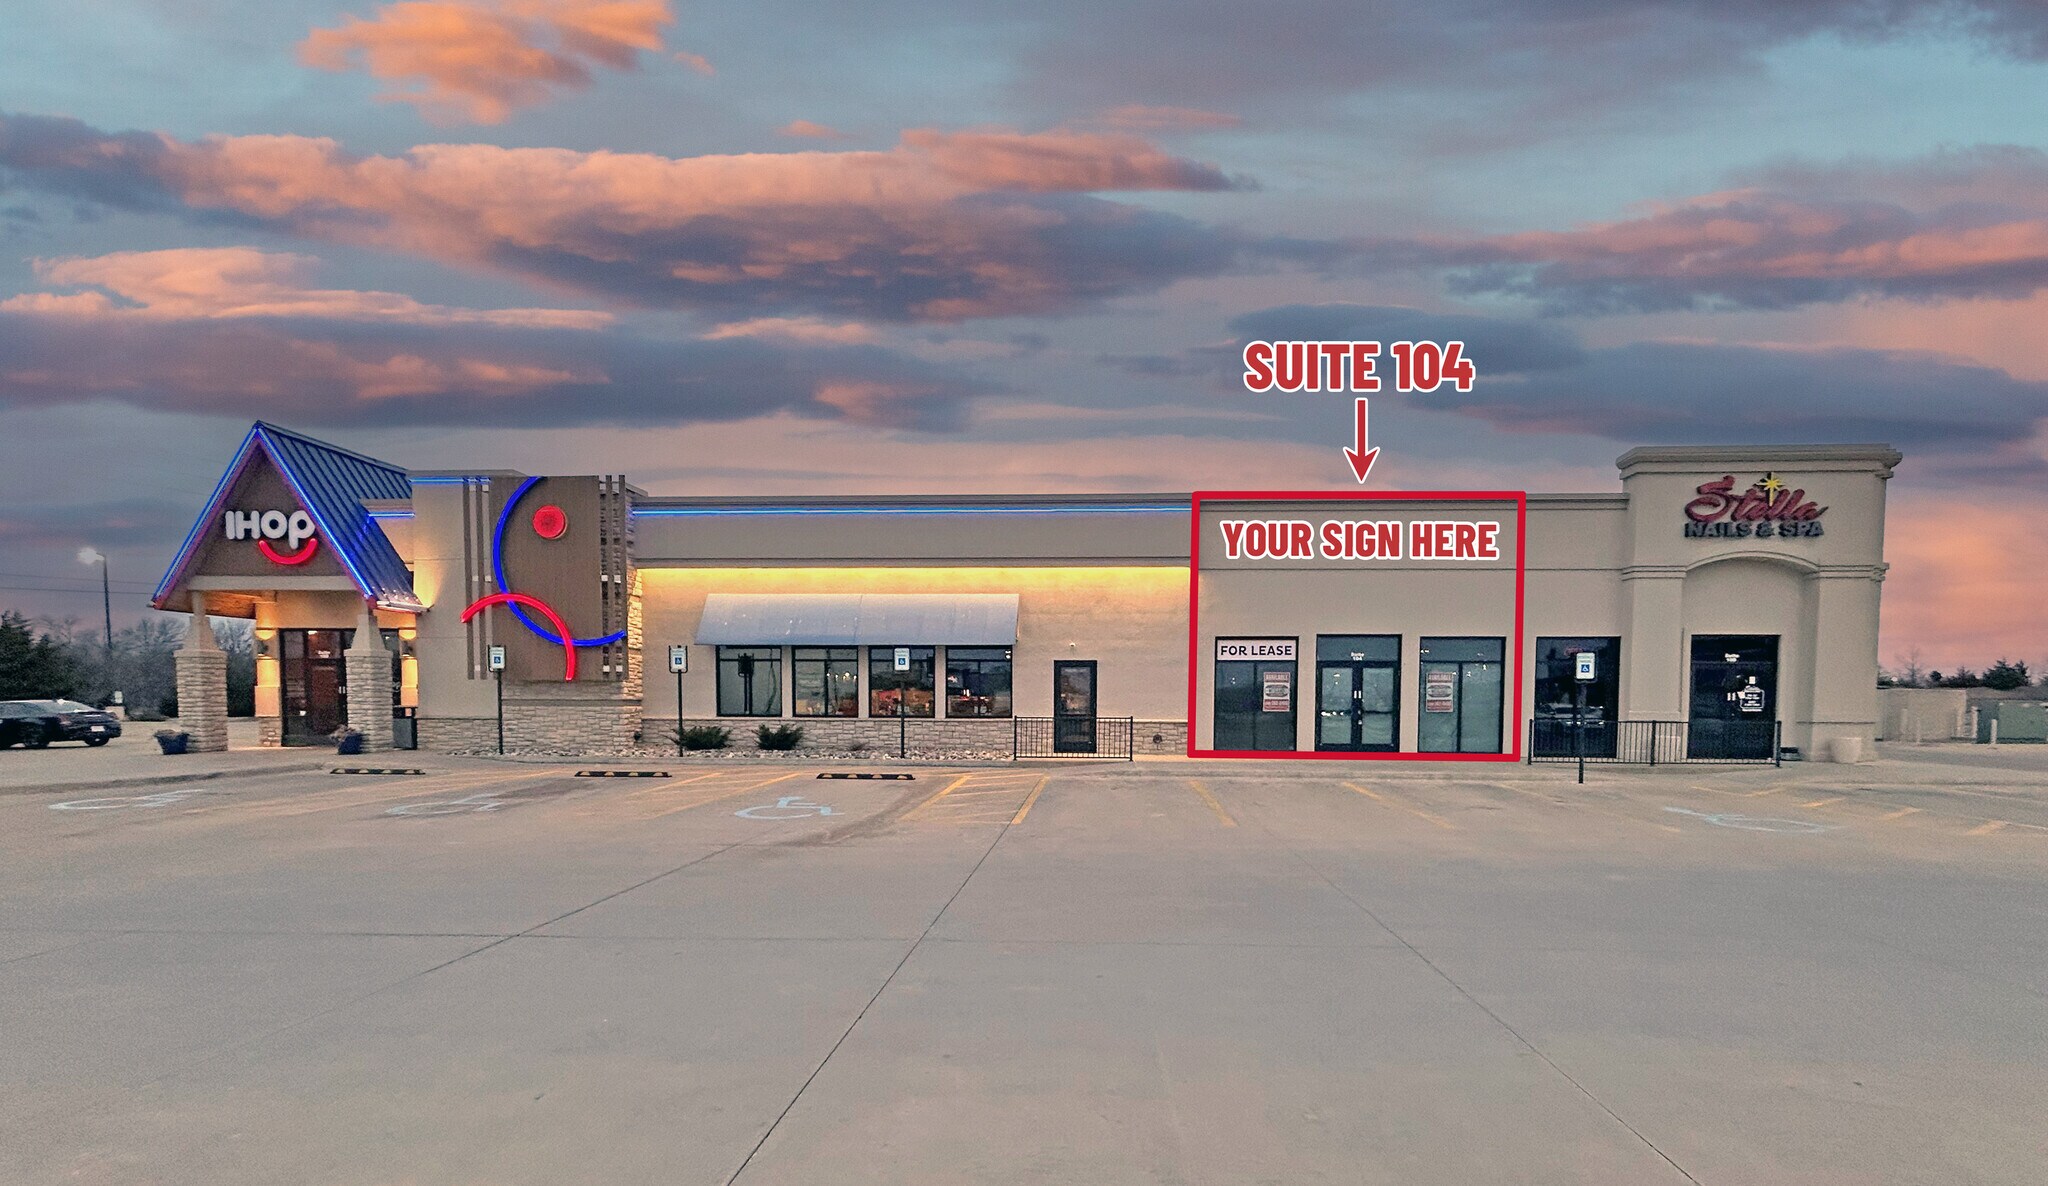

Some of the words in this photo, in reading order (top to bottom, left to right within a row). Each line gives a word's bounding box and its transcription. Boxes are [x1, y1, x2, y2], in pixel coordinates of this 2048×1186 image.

[1684, 475, 1829, 522] Stella
[1684, 520, 1752, 538] NAILS
[1755, 520, 1775, 538] &
[1778, 520, 1825, 538] SPA
[1220, 645, 1248, 656] FOR
[1251, 645, 1293, 656] LEASE
